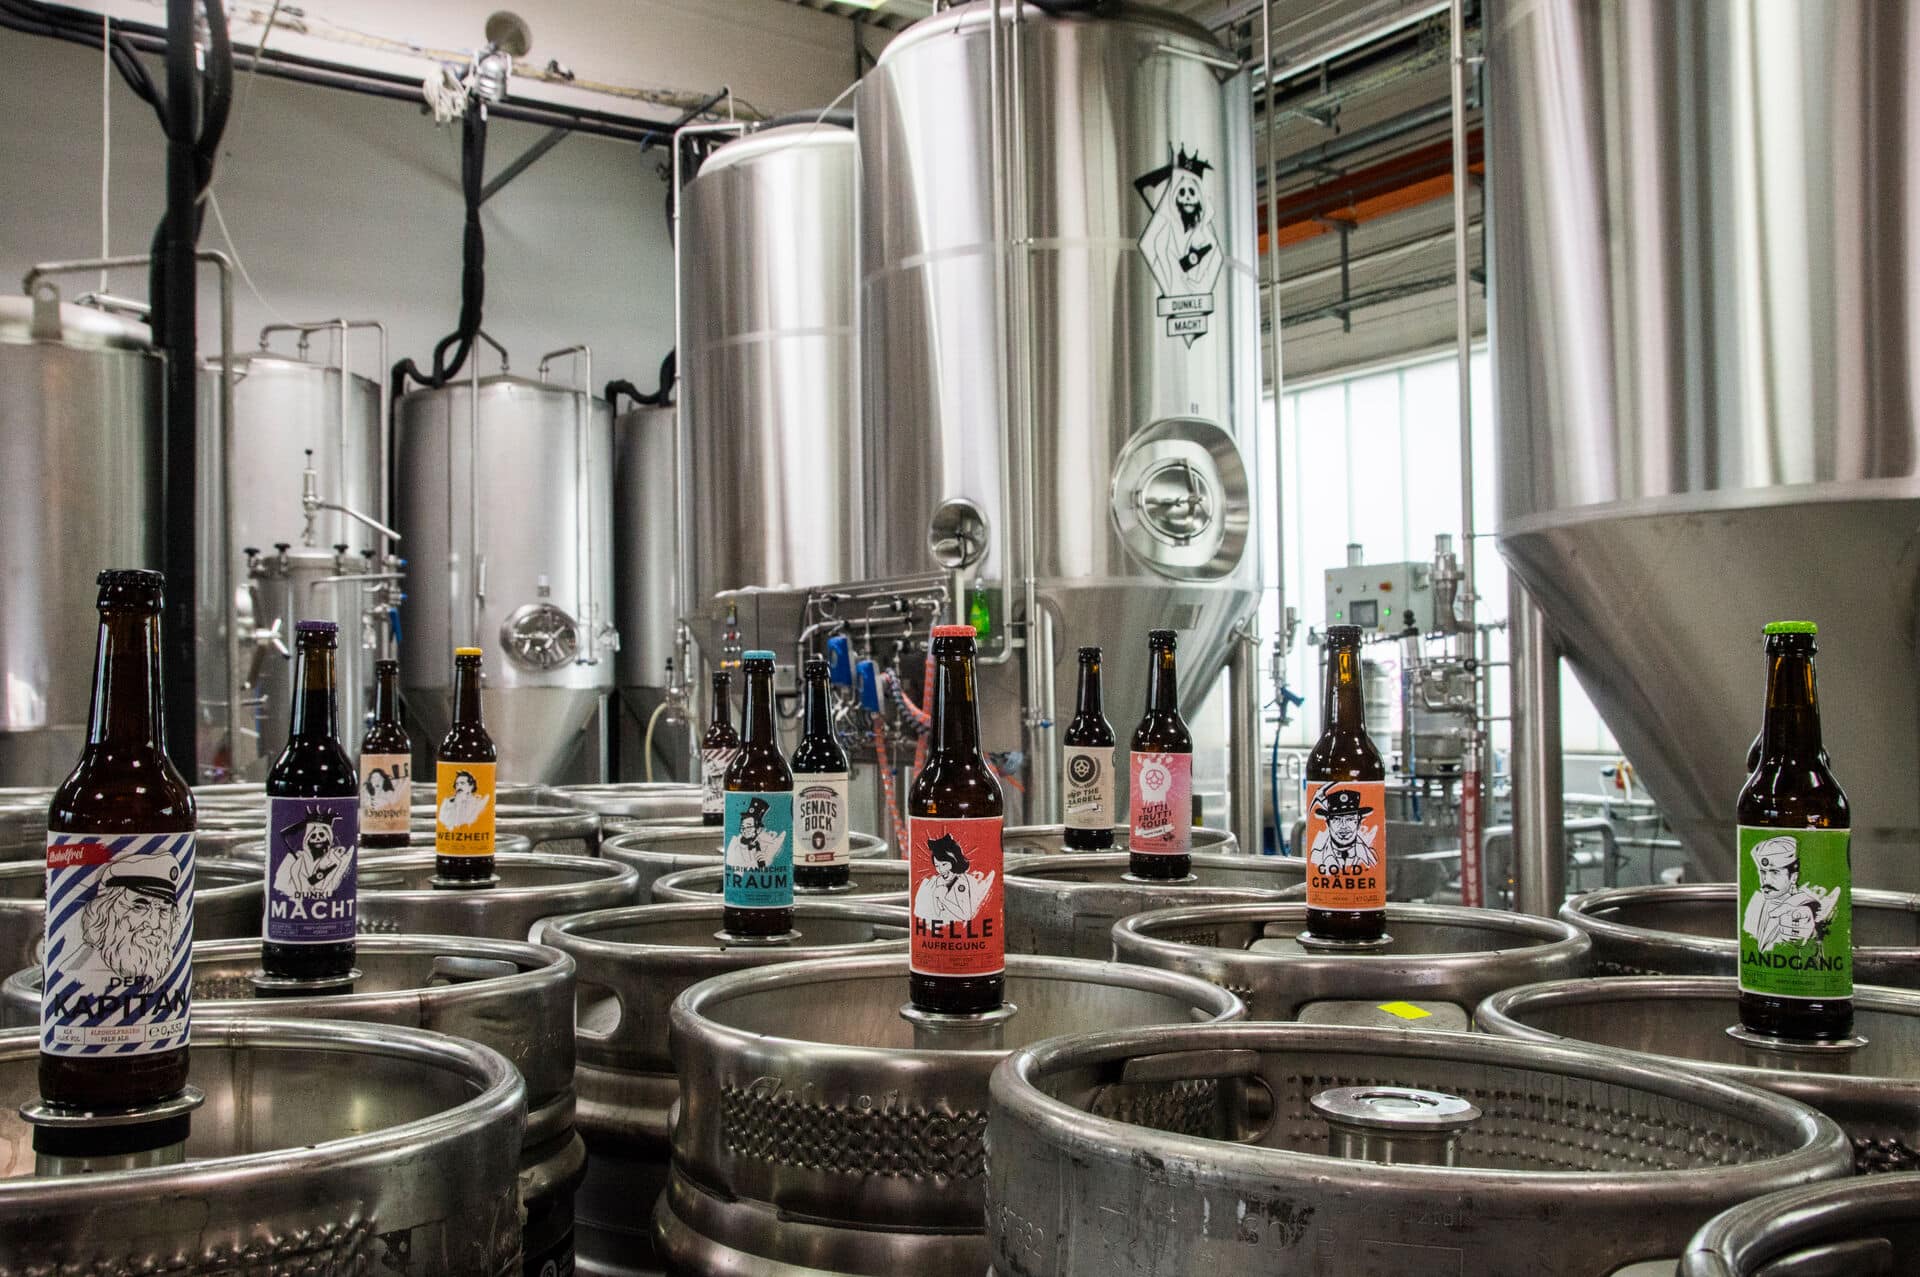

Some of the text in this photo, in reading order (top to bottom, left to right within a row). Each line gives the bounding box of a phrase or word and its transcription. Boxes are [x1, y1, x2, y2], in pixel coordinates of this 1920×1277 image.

[1172, 298, 1203, 310] DUNKLE
[1174, 320, 1202, 331] MACHT
[800, 800, 838, 818] SENATS
[804, 815, 833, 832] BOCK
[437, 831, 490, 841] WEIZHEIT
[1317, 864, 1370, 876] GOLD-
[725, 873, 788, 889] TRAUM
[1311, 875, 1377, 889] GRÄBER
[271, 899, 355, 920] MACHT
[915, 917, 993, 939] HELLE
[921, 941, 986, 952] AUFREGUNG
[1741, 950, 1844, 971] LANDGANG
